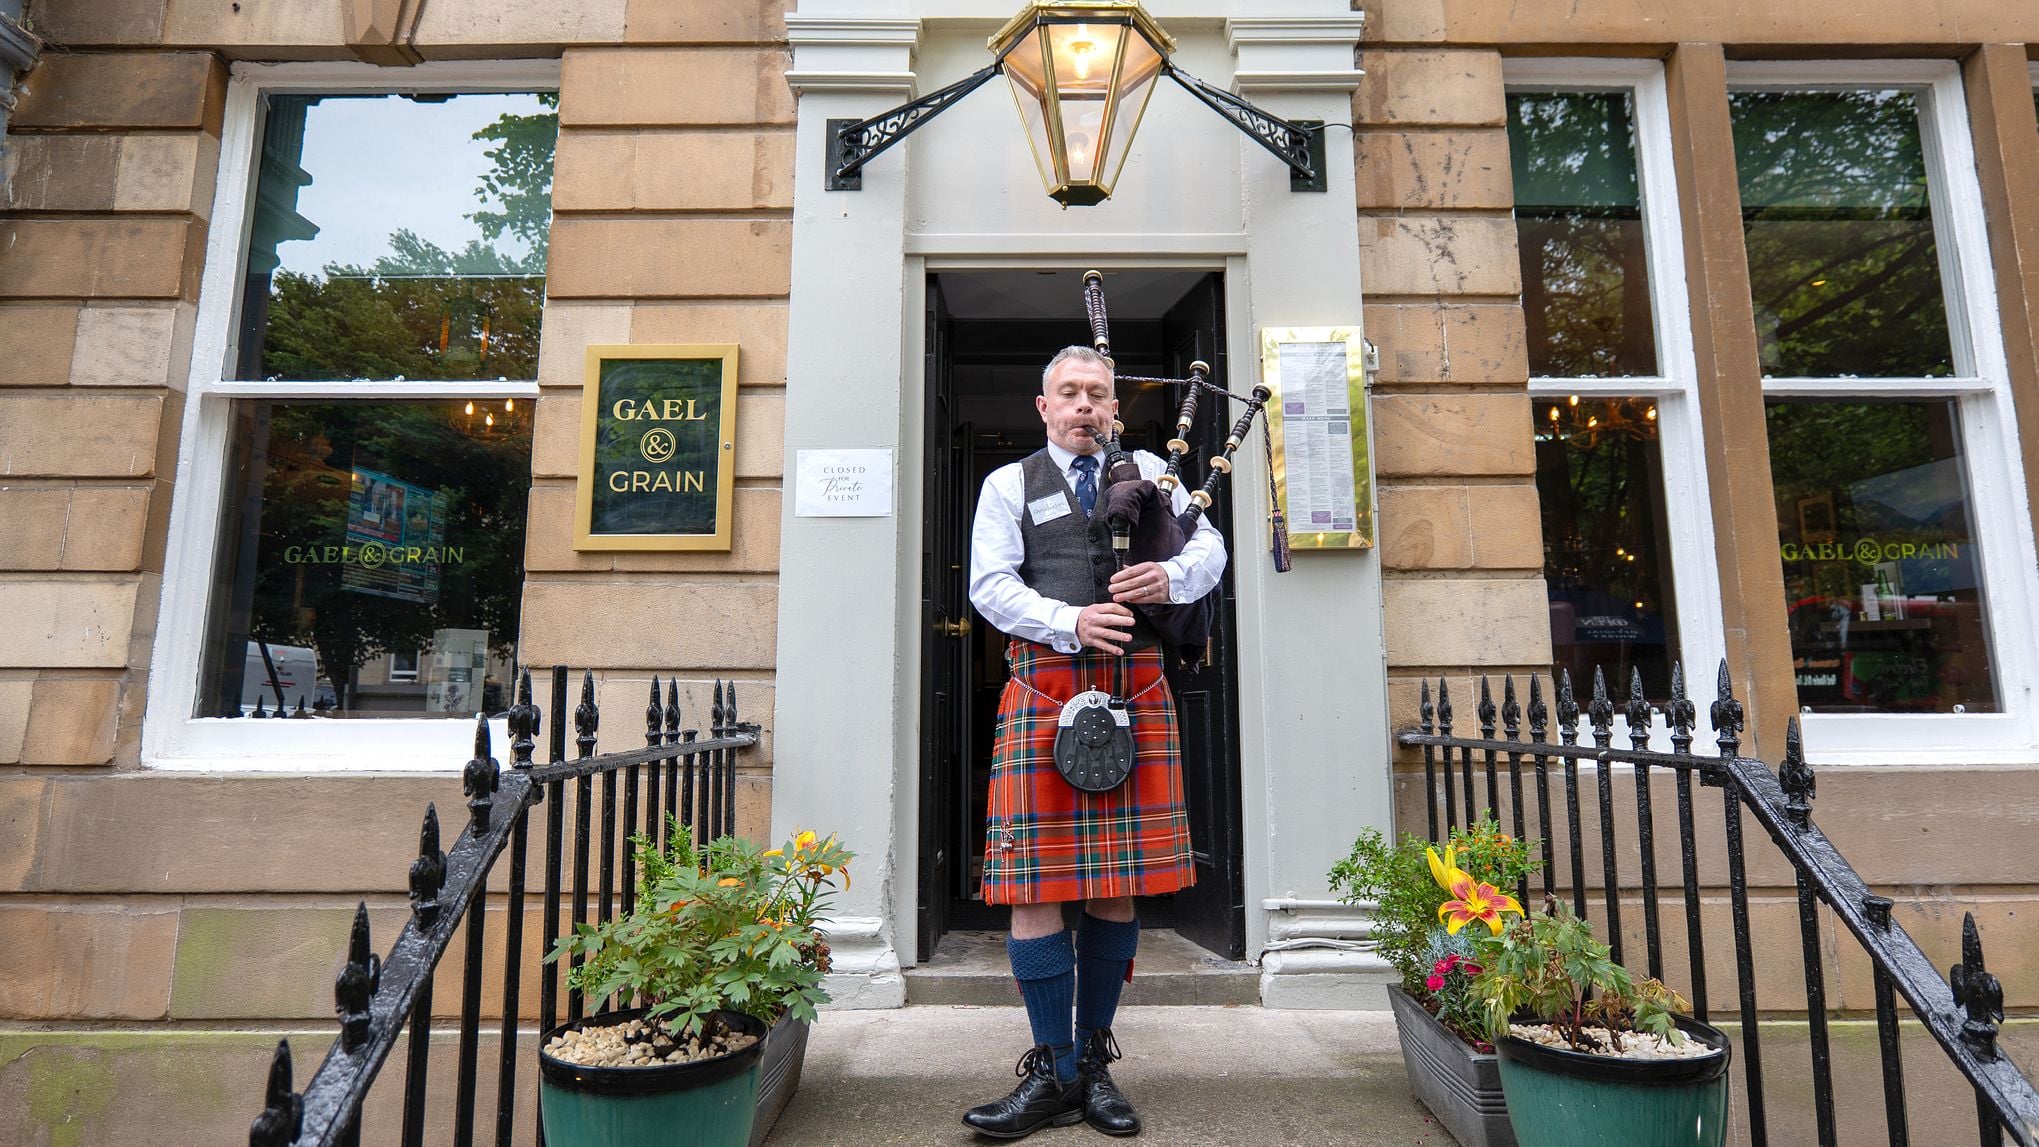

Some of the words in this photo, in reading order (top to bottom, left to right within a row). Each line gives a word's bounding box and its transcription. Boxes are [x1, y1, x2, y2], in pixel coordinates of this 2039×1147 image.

[612, 399, 708, 421] GAEL
[609, 471, 705, 493] GRAIN
[818, 477, 864, 496] Private
[827, 494, 861, 502] EVENT
[284, 546, 359, 564] GAEL
[389, 546, 464, 564] GRAIN
[1780, 543, 1854, 561] GAEL
[1884, 543, 1959, 560] GRAIN
